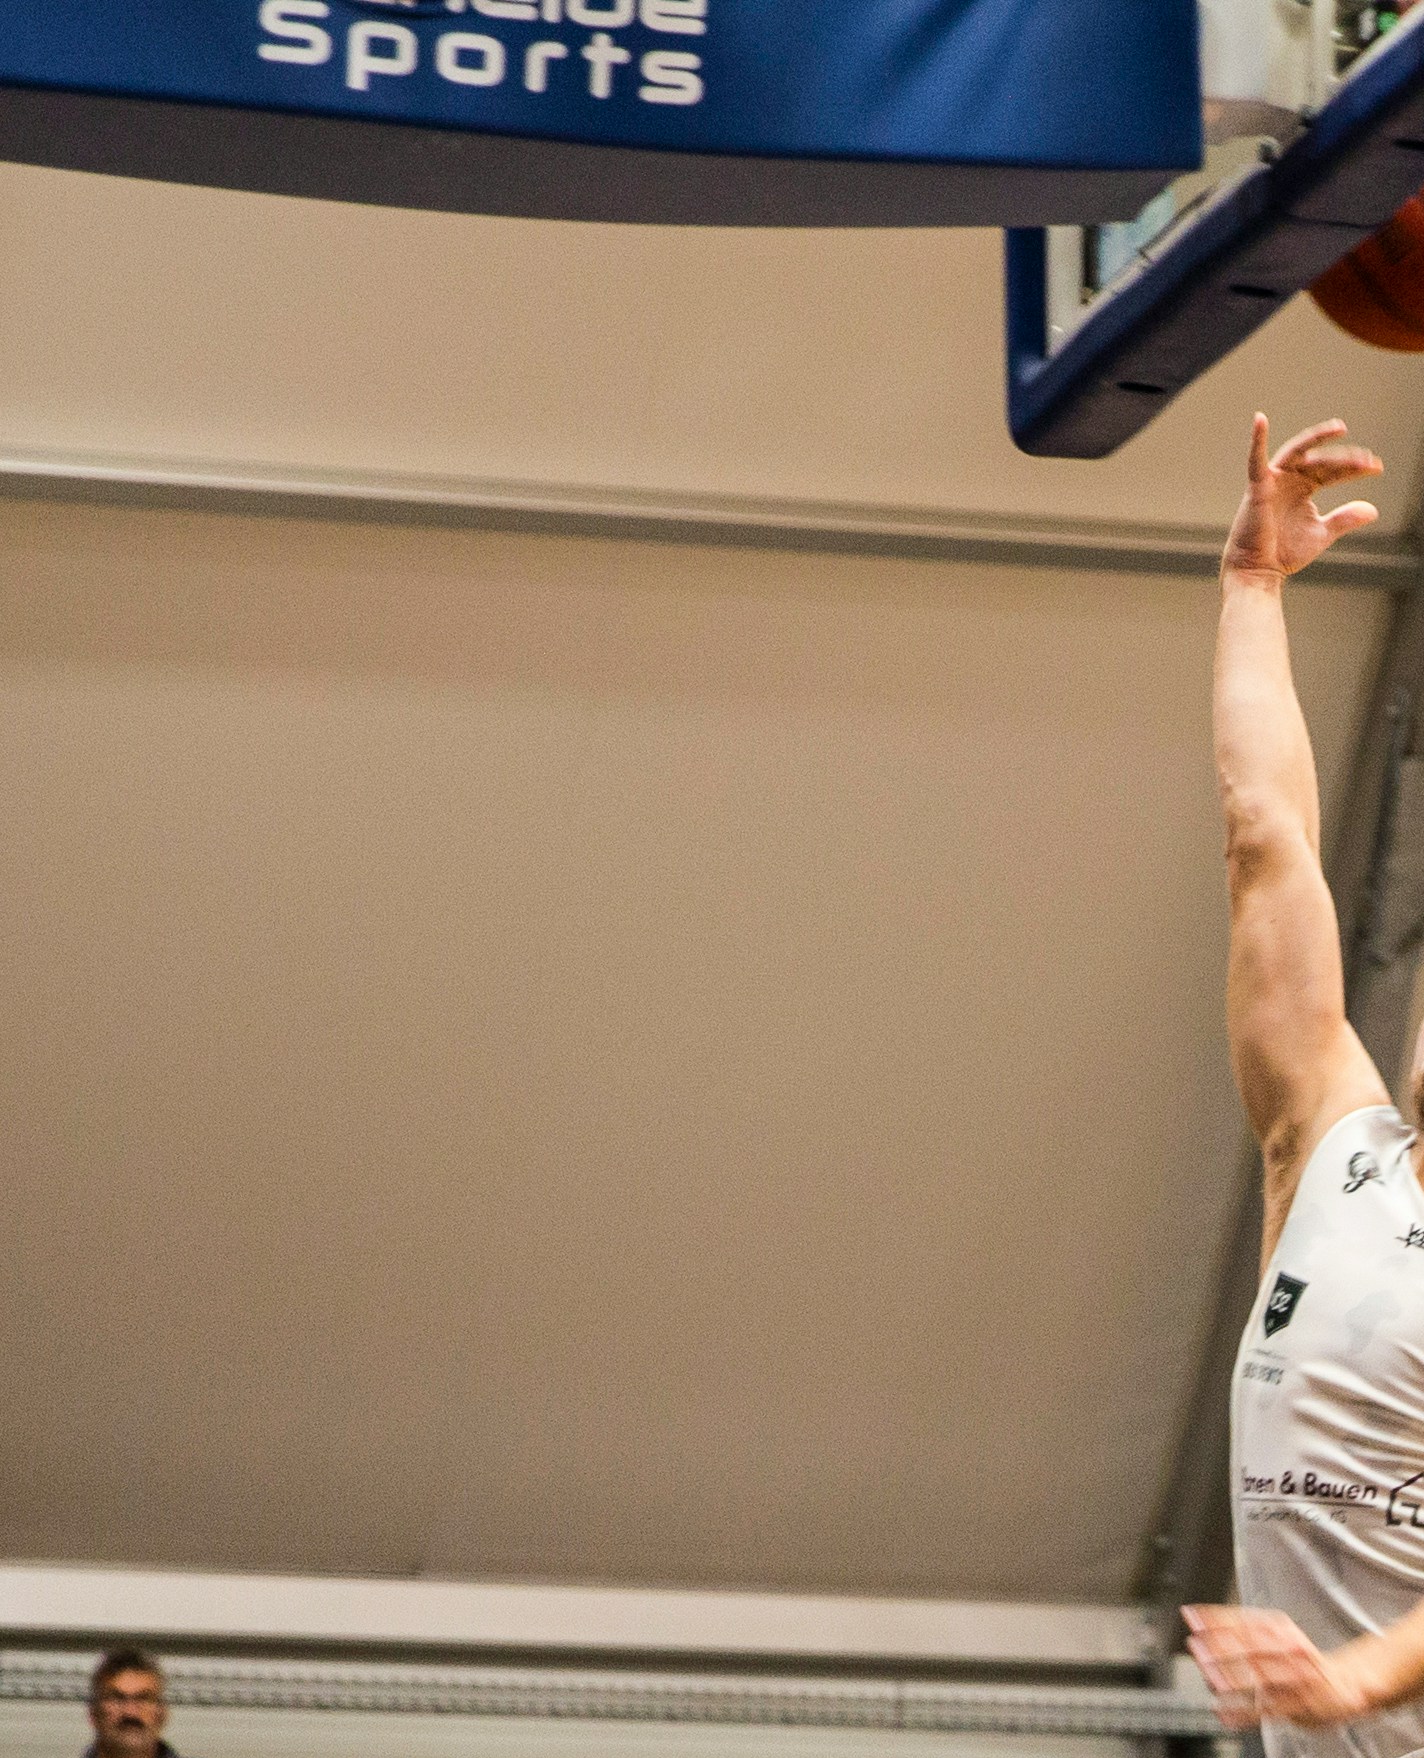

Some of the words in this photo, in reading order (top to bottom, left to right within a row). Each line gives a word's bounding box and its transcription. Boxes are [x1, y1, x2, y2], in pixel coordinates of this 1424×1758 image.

[257, 2, 703, 105] Sports
[1280, 1470, 1297, 1495] &
[1303, 1471, 1378, 1500] Bauen
